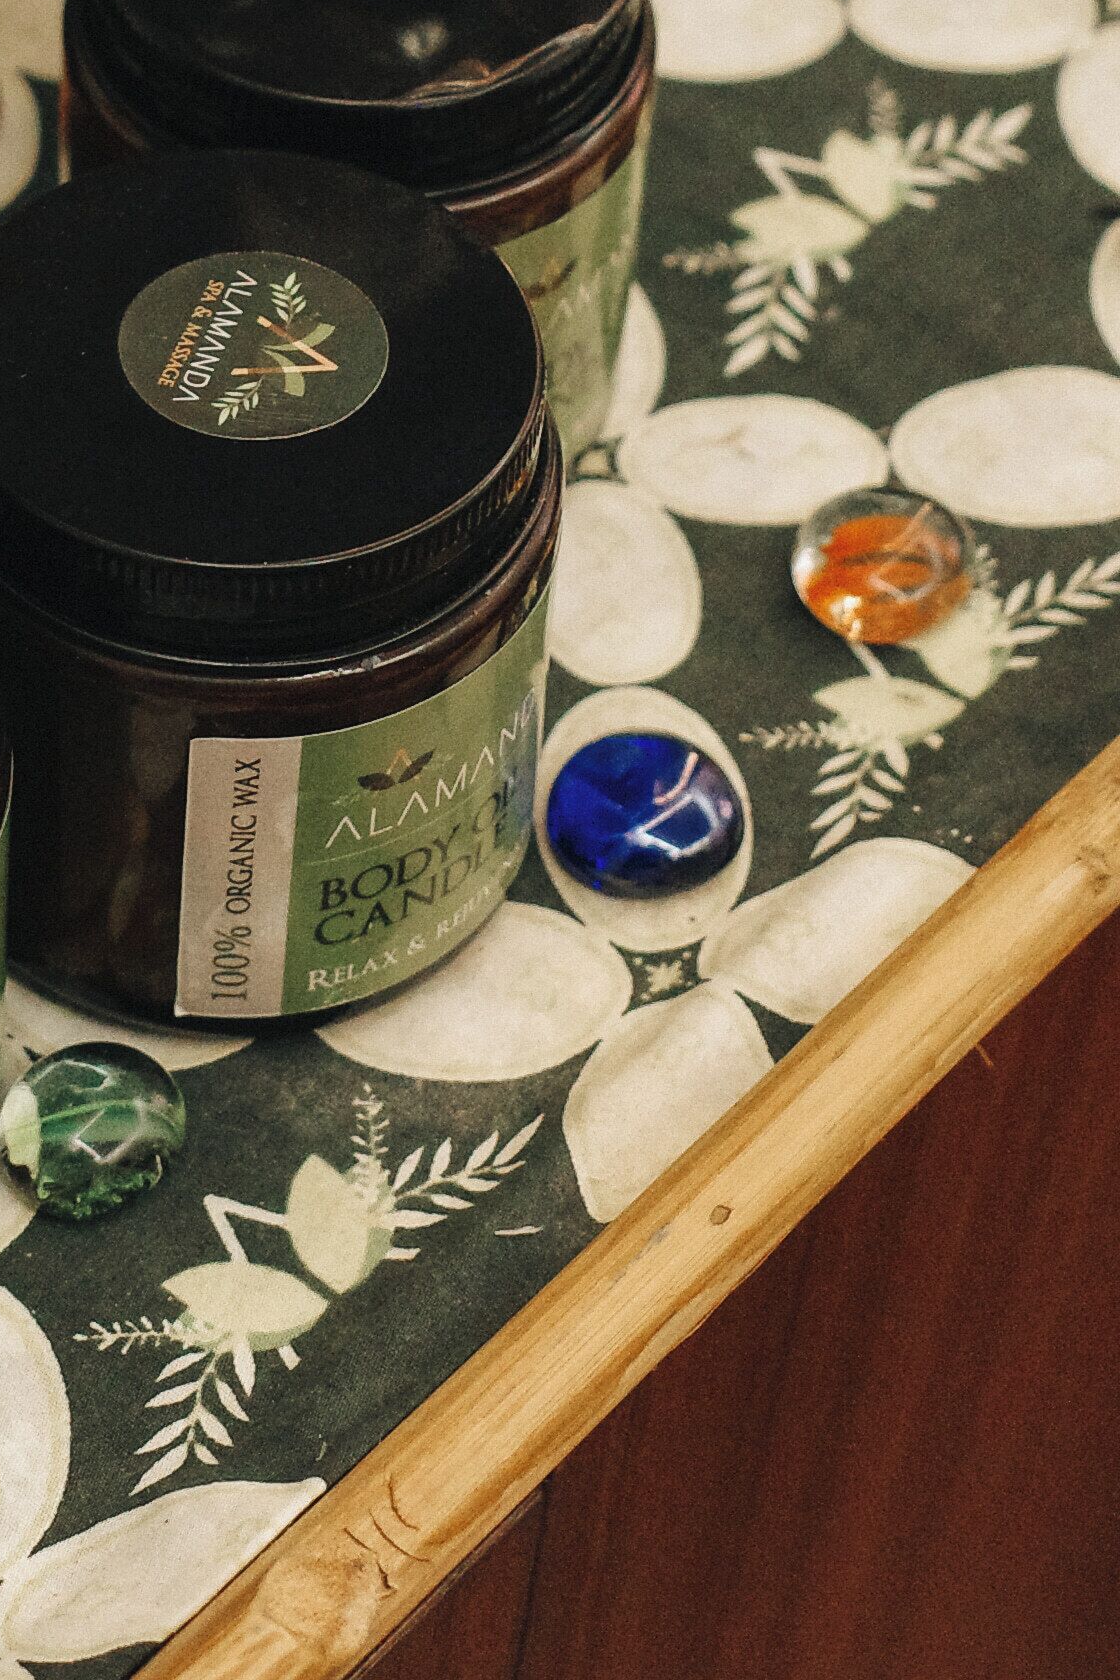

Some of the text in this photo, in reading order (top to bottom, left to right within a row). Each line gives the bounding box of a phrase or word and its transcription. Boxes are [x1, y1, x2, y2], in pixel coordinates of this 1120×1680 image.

[157, 279, 225, 388] SPA & MASSAGE
[173, 270, 257, 402] ALAMANDA
[211, 757, 262, 1002] 100% ORGANIC WAX
[319, 824, 460, 912] BODY
[307, 935, 426, 992] RELAX &
